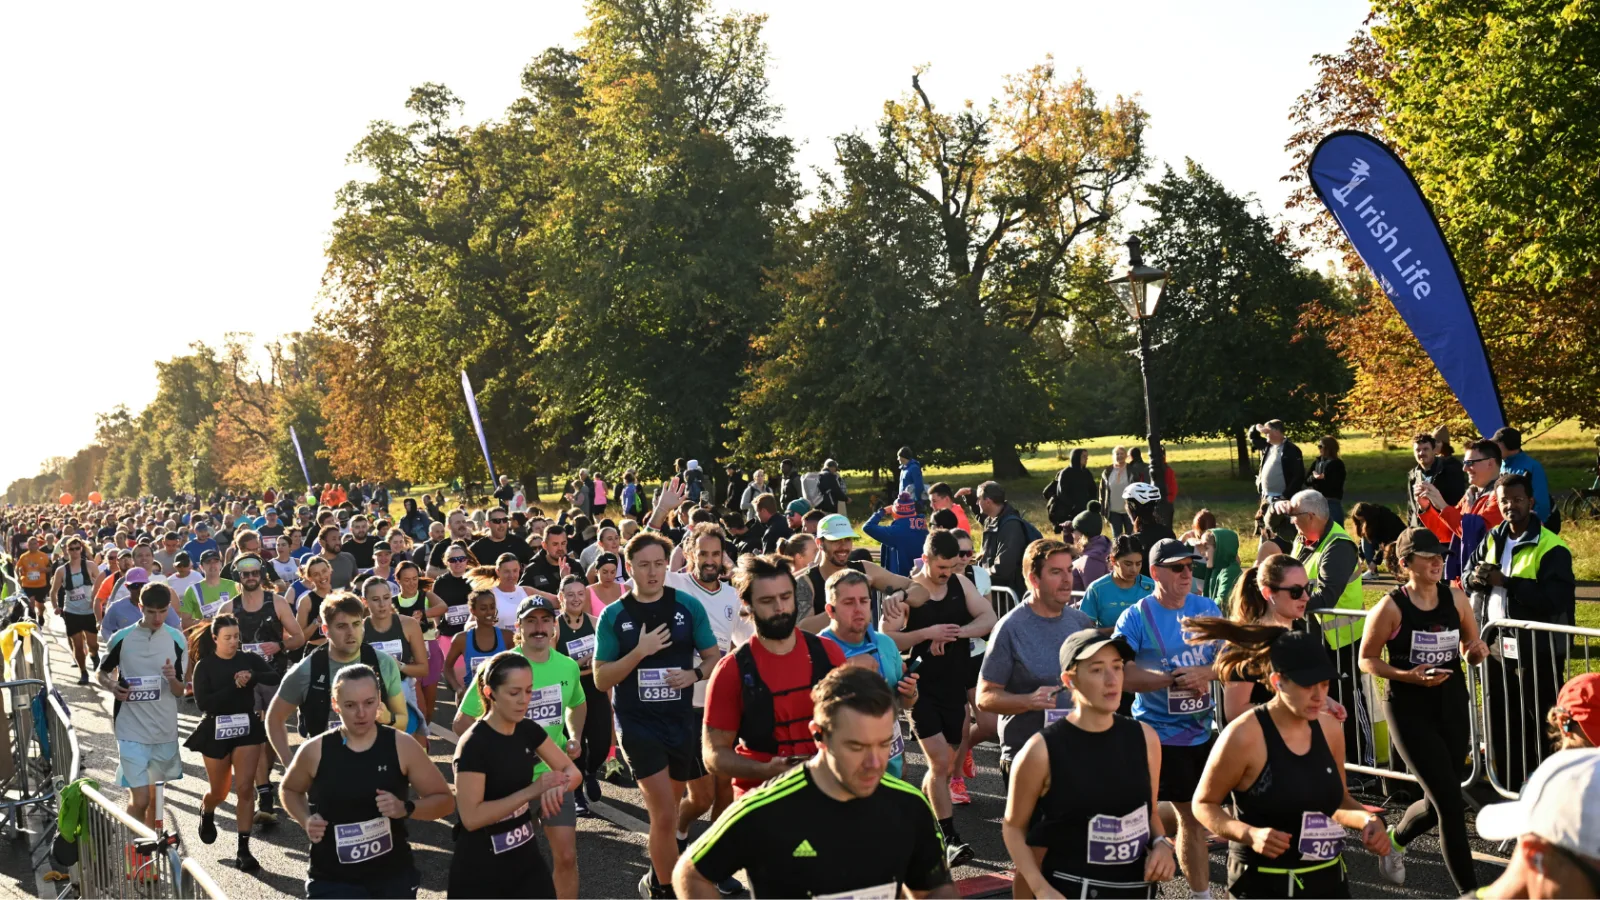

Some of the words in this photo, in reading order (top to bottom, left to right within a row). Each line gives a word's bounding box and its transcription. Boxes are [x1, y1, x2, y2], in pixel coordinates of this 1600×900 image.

[1354, 194, 1399, 254] Irish
[1391, 247, 1432, 301] Life
[450, 614, 468, 624] 5517
[1171, 645, 1208, 667] 10K
[1416, 651, 1452, 663] 4098
[129, 690, 156, 701] 6926
[644, 688, 676, 699] 6385
[1179, 699, 1203, 711] 636
[527, 705, 557, 719] 1502
[220, 727, 245, 738] 7020
[505, 824, 530, 846] 694
[350, 841, 382, 860] 670
[1104, 840, 1140, 860] 287
